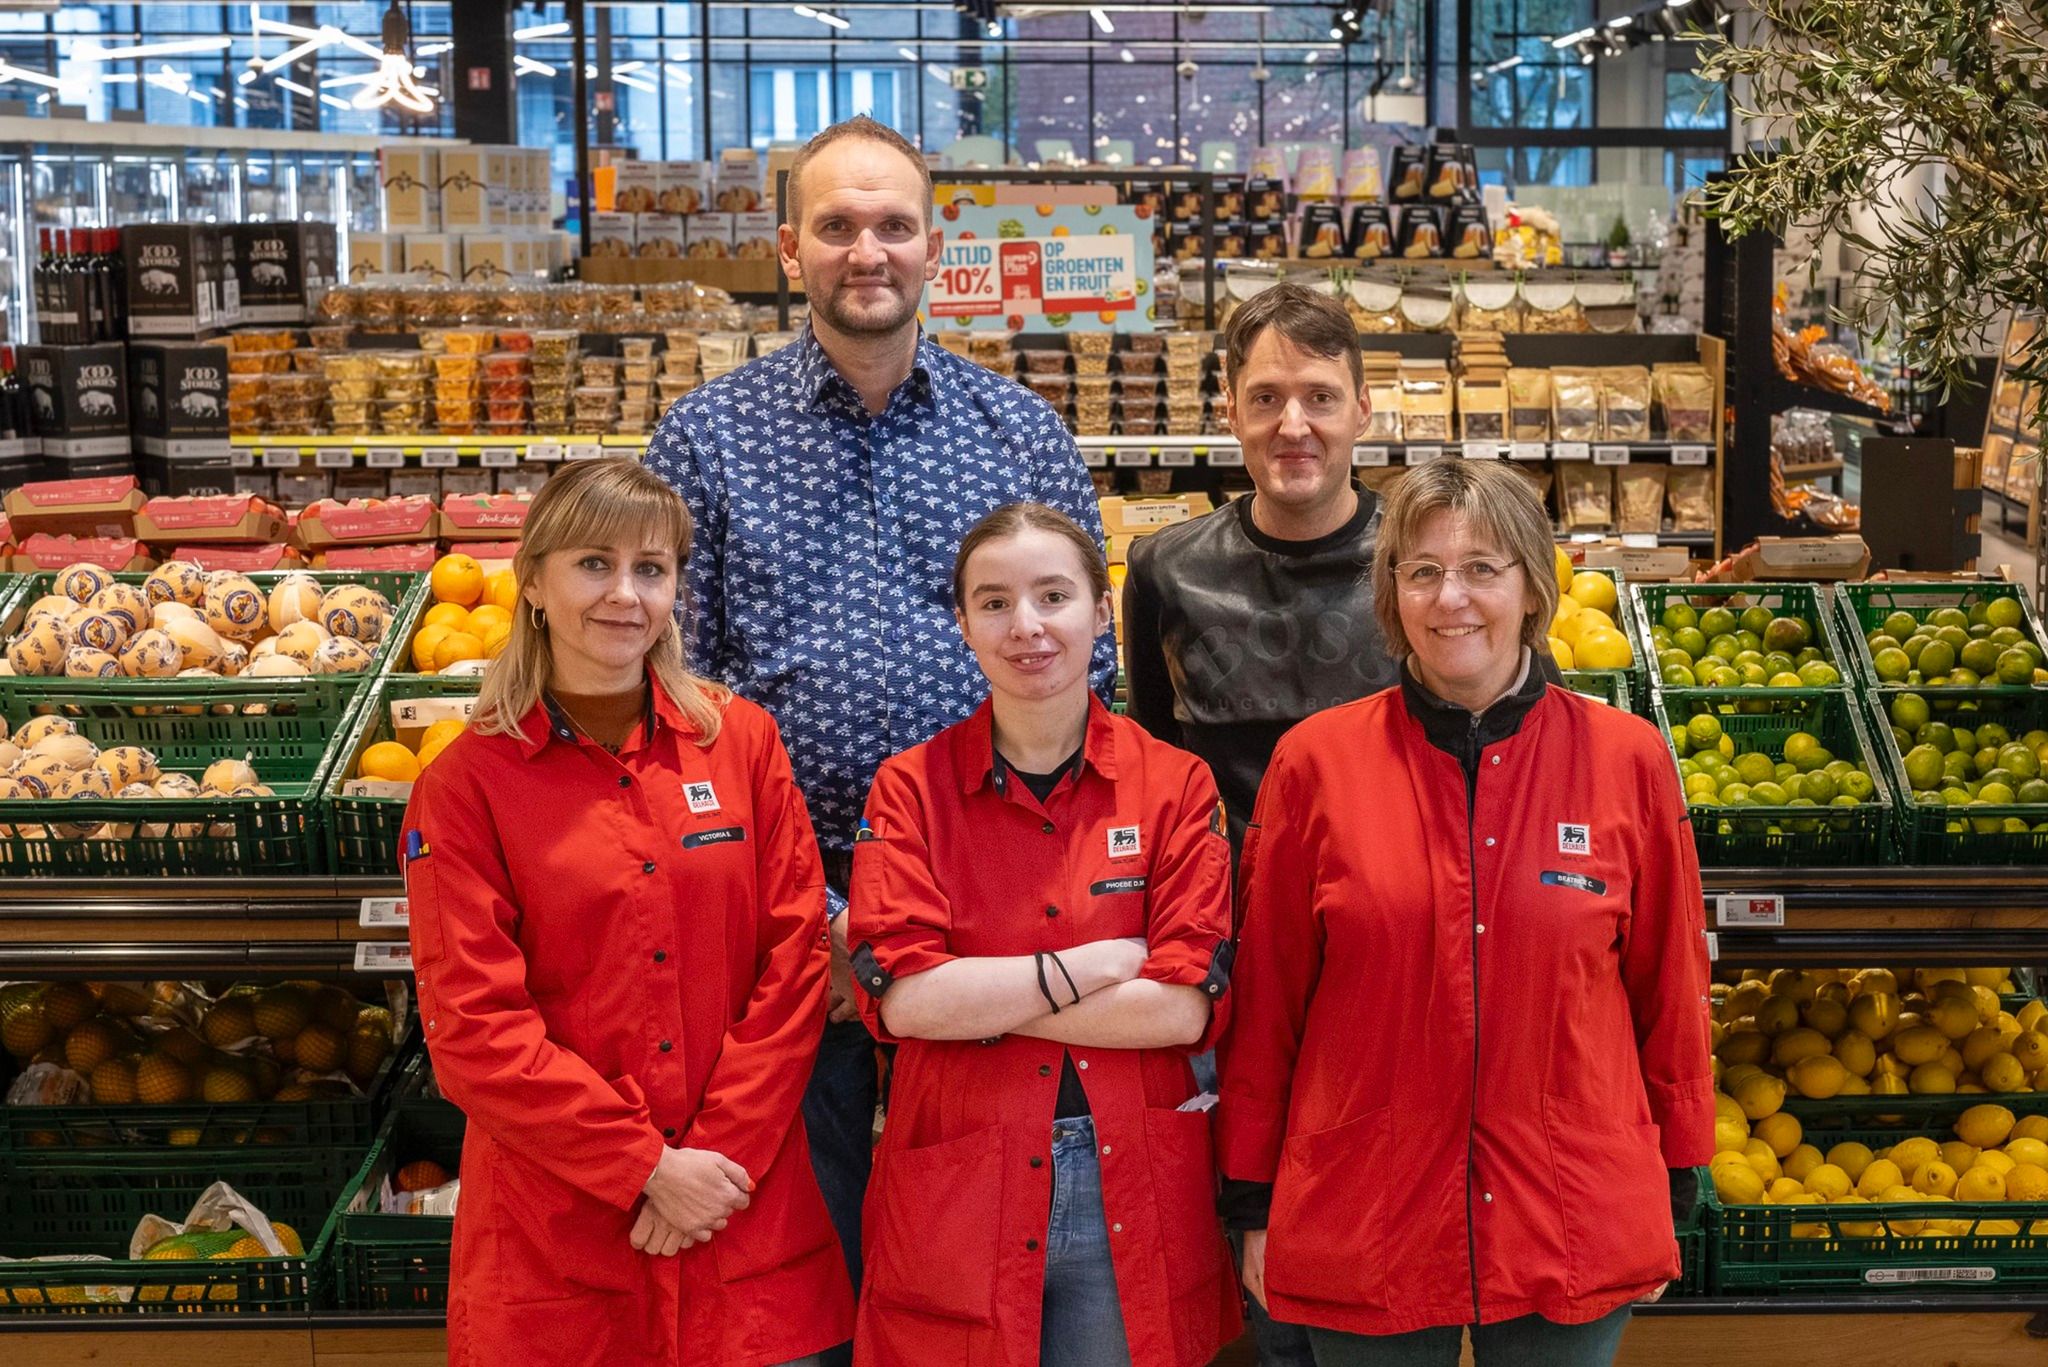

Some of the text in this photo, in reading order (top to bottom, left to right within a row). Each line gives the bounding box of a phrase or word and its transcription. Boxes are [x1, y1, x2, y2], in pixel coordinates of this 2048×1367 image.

[1045, 242, 1064, 257] OP
[1045, 257, 1124, 275] GROENTEN
[934, 267, 993, 295] -10%
[1046, 274, 1111, 292] EN FRUIT
[476, 513, 520, 525] Pink Lady
[1201, 698, 1278, 711] HUGO
[698, 831, 726, 841] VICTORIA
[1562, 843, 1586, 851] DELHAIZE
[1105, 881, 1132, 889] PHOEBE
